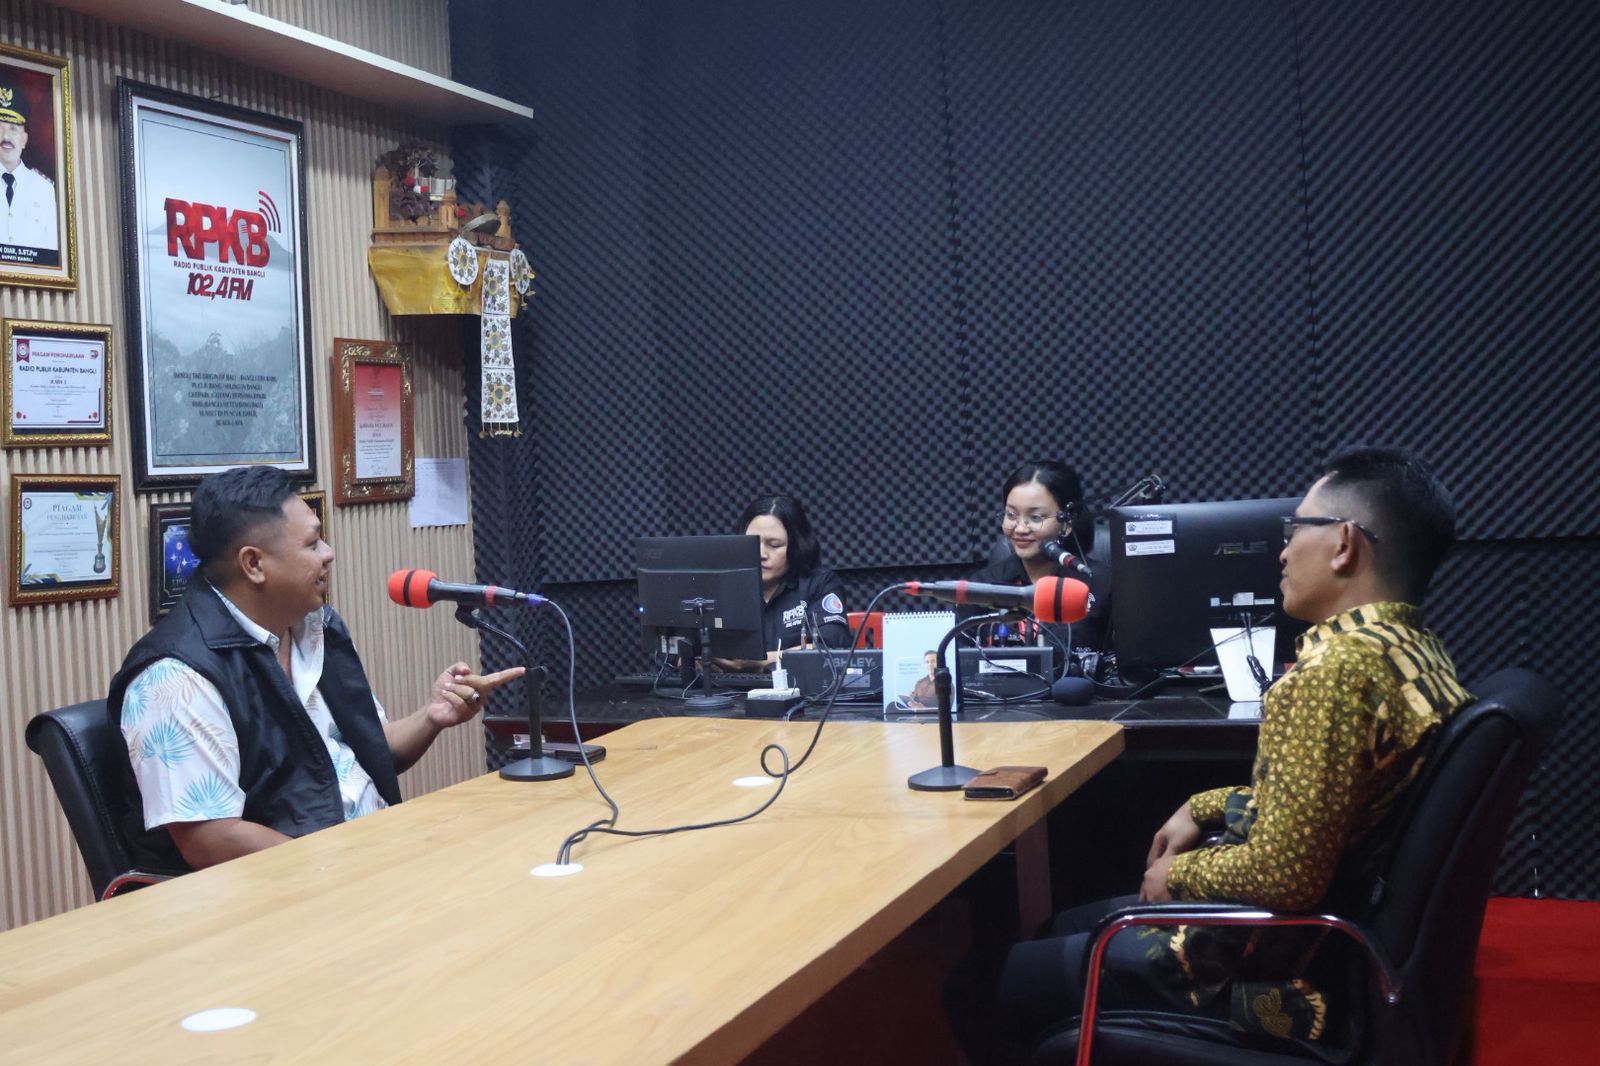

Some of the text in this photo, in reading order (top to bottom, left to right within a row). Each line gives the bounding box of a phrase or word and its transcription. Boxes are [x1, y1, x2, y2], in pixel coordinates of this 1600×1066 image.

[164, 197, 270, 268] RPKB
[173, 260, 266, 278] RADIO PUBLIK KABUPATEN BANGLI
